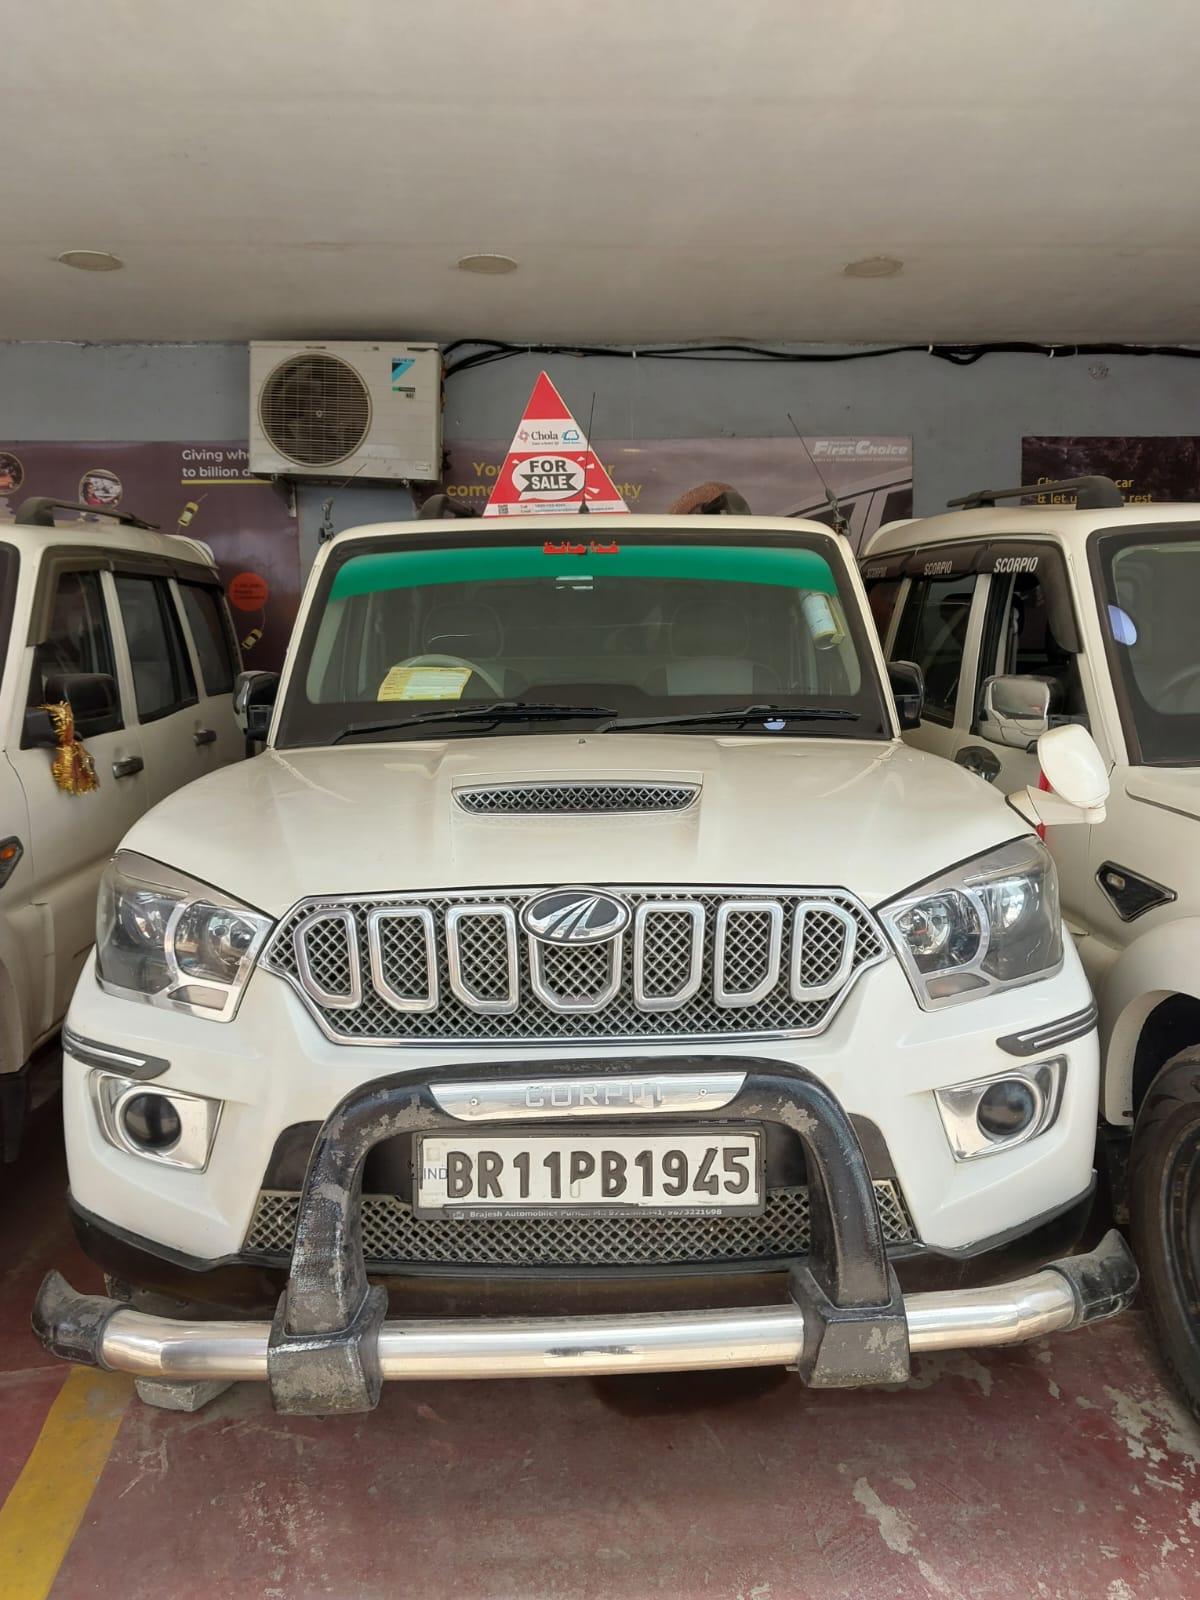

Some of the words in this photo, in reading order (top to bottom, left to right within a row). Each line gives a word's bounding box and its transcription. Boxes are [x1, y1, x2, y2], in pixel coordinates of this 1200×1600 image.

[531, 431, 559, 441] Chola
[182, 449, 223, 463] Giving
[182, 468, 196, 478] to
[200, 466, 239, 478] billion
[529, 460, 568, 473] FOR
[531, 475, 568, 490] SALE
[1115, 479, 1135, 488] car
[1050, 492, 1067, 504] let
[1129, 494, 1153, 504] rest
[923, 560, 953, 576] SCORPIO
[993, 556, 1039, 574] SCORPIO
[423, 1167, 448, 1180] IND
[446, 1146, 751, 1199] BR11PB1945
[469, 1209, 503, 1219] Brajesh
